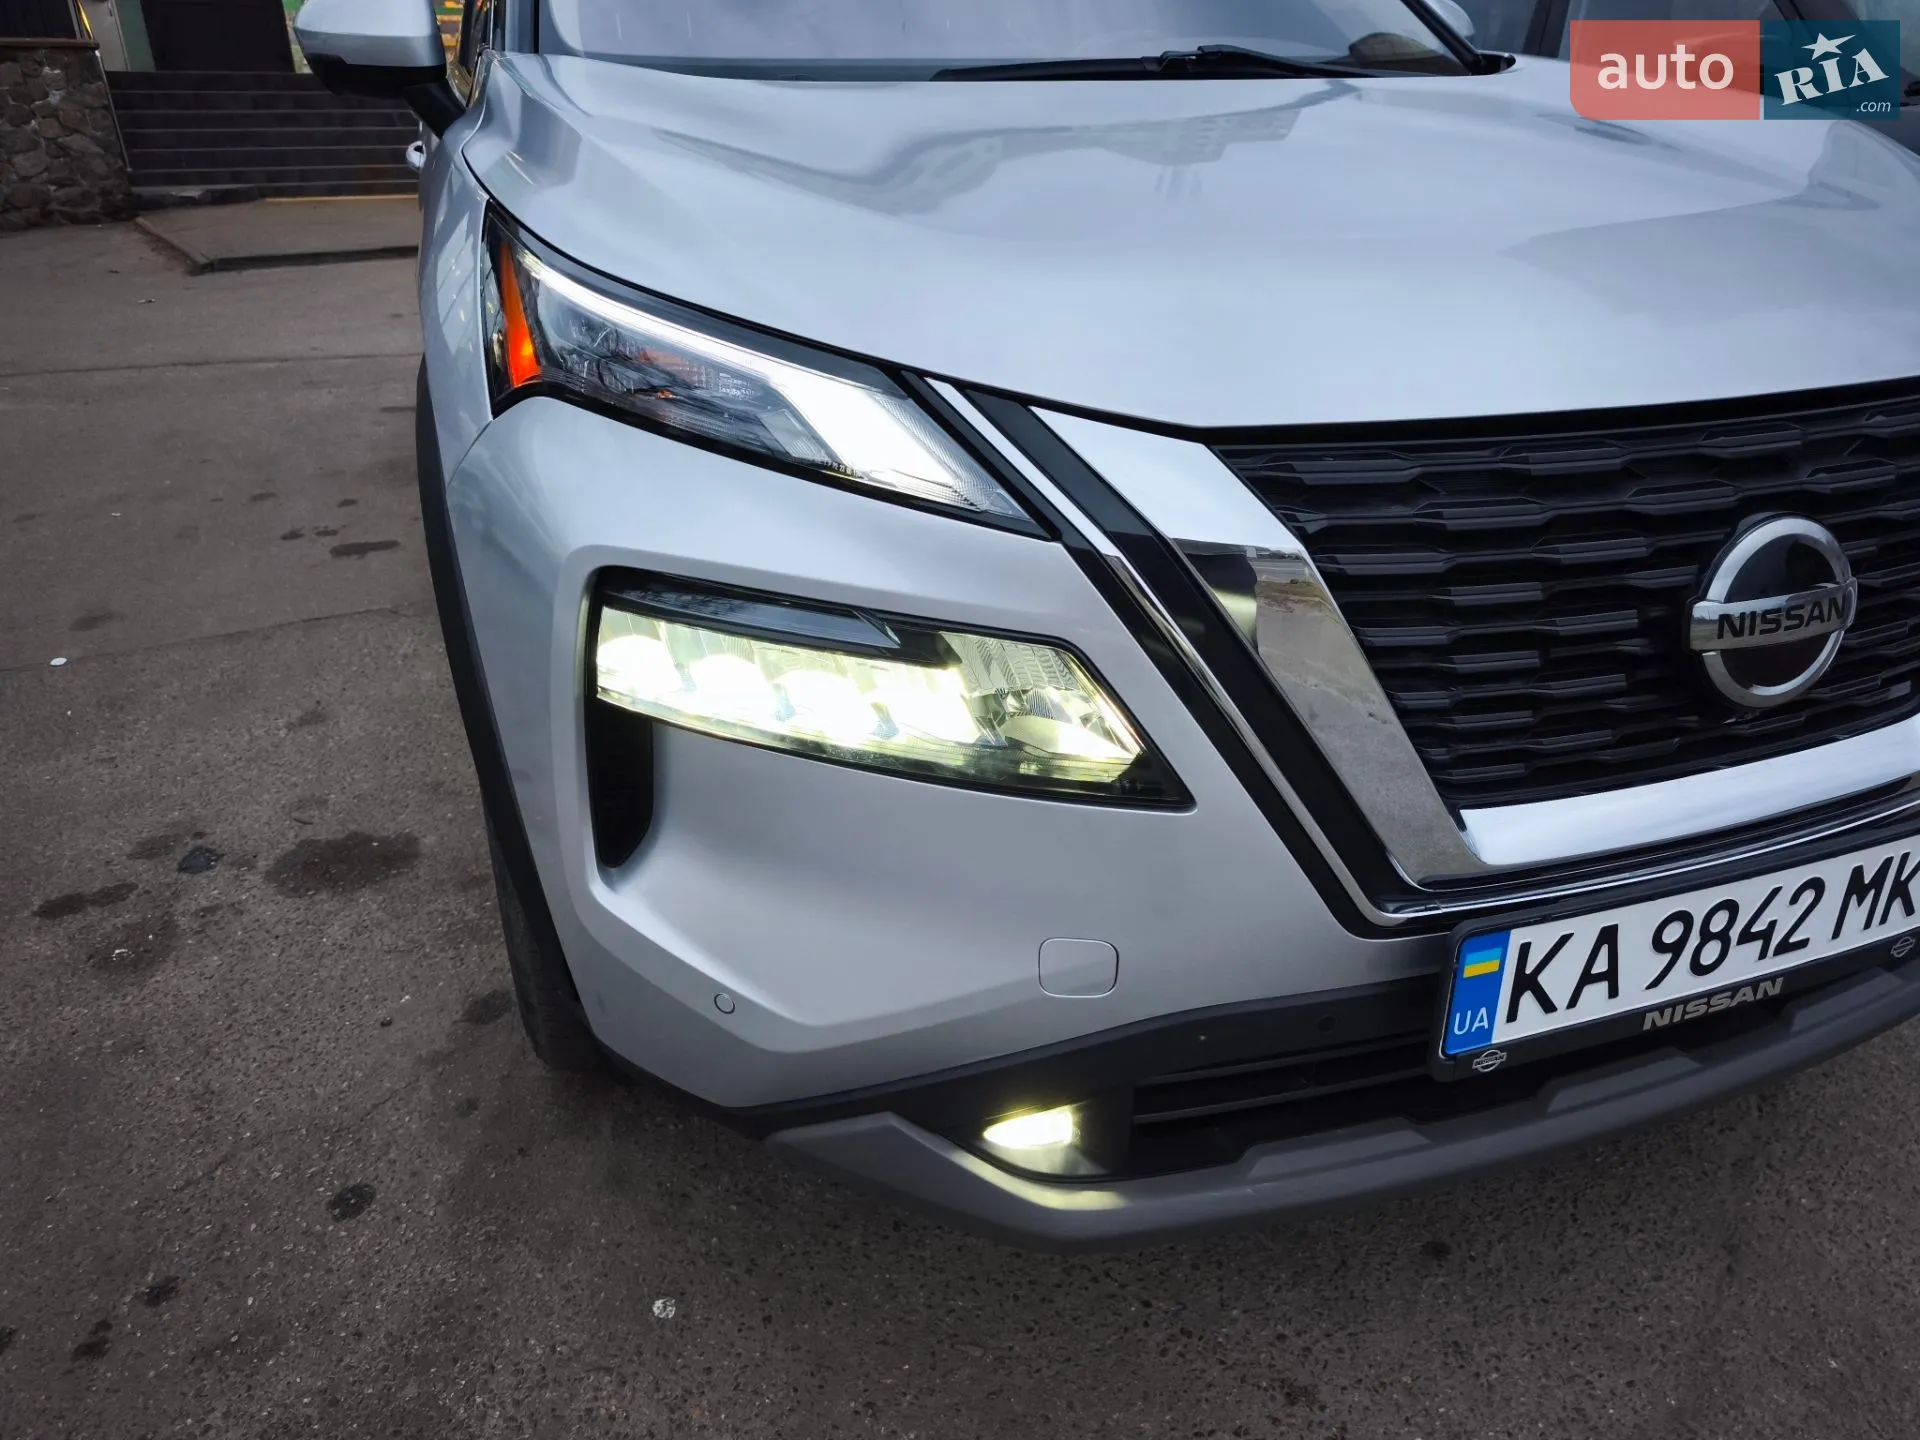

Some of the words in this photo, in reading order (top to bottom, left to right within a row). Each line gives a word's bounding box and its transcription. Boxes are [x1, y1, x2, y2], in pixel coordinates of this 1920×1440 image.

[1716, 595, 1847, 640] NISSAN
[1506, 923, 1619, 1024] KA
[1643, 876, 1826, 991] 9842
[1831, 851, 1920, 940] MK
[1453, 1007, 1489, 1035] UA
[1642, 977, 1784, 1031] NISSAN
